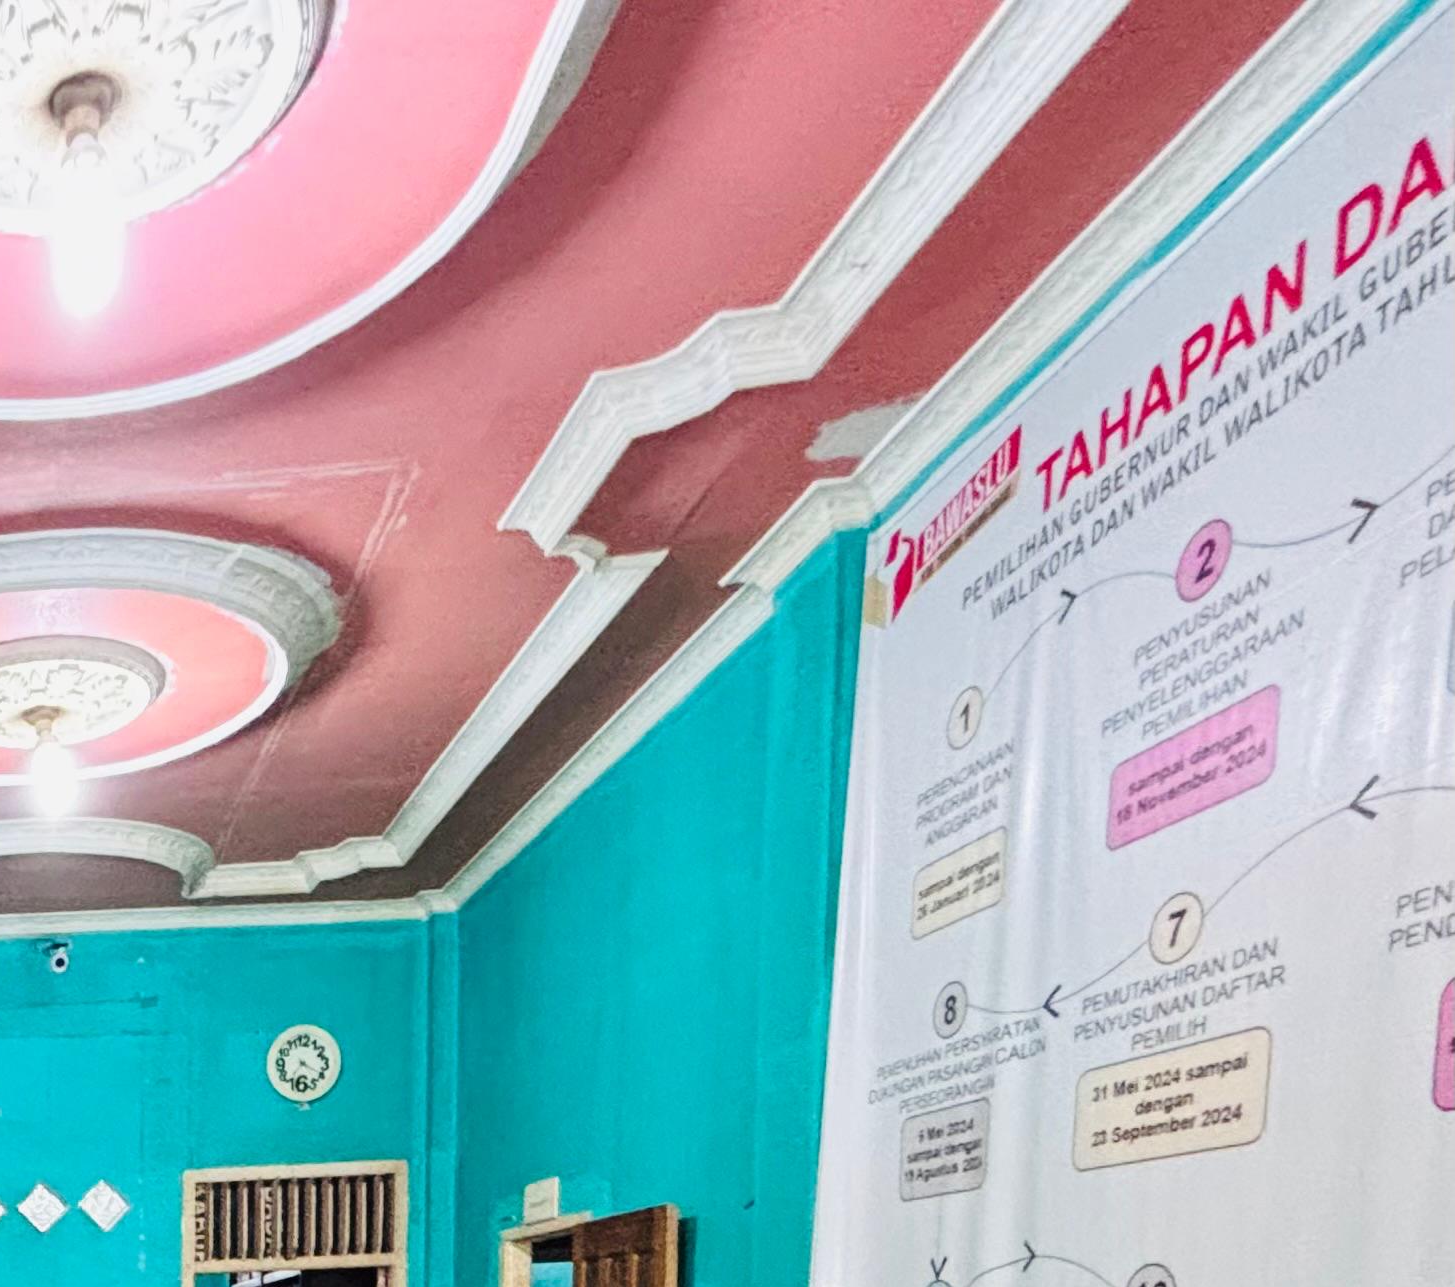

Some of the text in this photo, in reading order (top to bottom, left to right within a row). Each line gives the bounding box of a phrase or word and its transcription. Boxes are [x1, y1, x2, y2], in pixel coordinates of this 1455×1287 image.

[1035, 238, 1308, 513] TAHAPAN
[962, 514, 1065, 610] PEMILIHAN
[1070, 412, 1192, 525] GUBERNUR
[1198, 365, 1250, 429] DAN
[1257, 292, 1347, 380] WAKIL
[1358, 204, 1455, 302] GUBE
[991, 533, 1086, 620] WALIKOTA
[1091, 497, 1135, 548] DAN
[1140, 436, 1217, 511] WAKIL
[1223, 321, 1368, 448] WALIKOTA
[921, 440, 1014, 563] BAWASLU
[1194, 538, 1217, 584] 2
[1400, 543, 1455, 589] PEL
[1132, 565, 1273, 667] PENYUSUNAN
[1138, 604, 1261, 690] PERATURAN
[1101, 606, 1307, 738] PENYELENGGARAAN
[959, 701, 971, 734] 1
[1141, 667, 1249, 740] PEMILIHAN
[1168, 907, 1188, 948] 7
[1082, 936, 1280, 1017] PEMUTAKHIRAN DAN
[944, 994, 957, 1026] 8
[1074, 964, 1288, 1043] PENYUSUNAN DAFTAR
[297, 1033, 311, 1048] 12
[1131, 1014, 1208, 1053] PEMILIH
[275, 1057, 286, 1072] 9
[295, 1074, 308, 1093] 6
[1144, 1066, 1182, 1091] 2024
[1184, 1051, 1250, 1082] sampai
[1110, 1114, 1197, 1146] September
[1201, 1102, 1244, 1129] 2024
